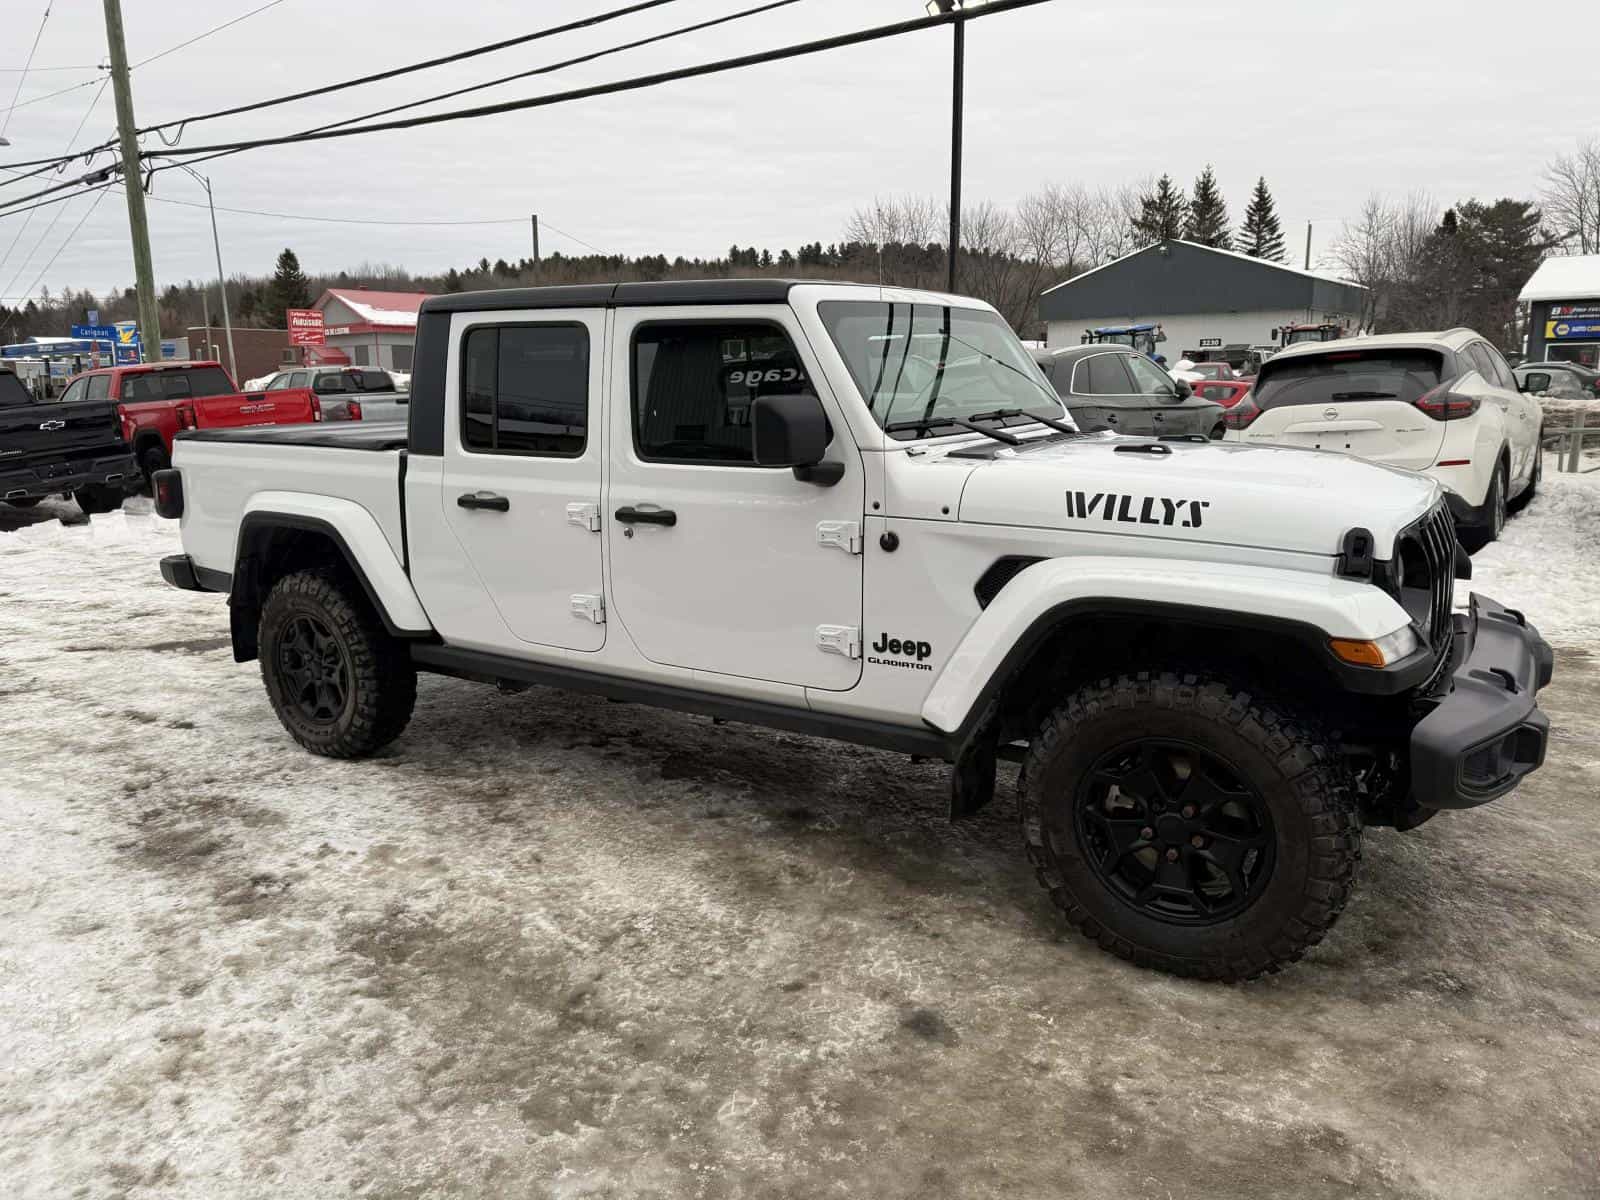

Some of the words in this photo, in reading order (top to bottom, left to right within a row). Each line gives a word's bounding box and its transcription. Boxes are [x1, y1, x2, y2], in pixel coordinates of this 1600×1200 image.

[1065, 490, 1210, 528] WILLYS
[872, 632, 932, 662] Jeep
[867, 656, 933, 671] GLADIATOR
